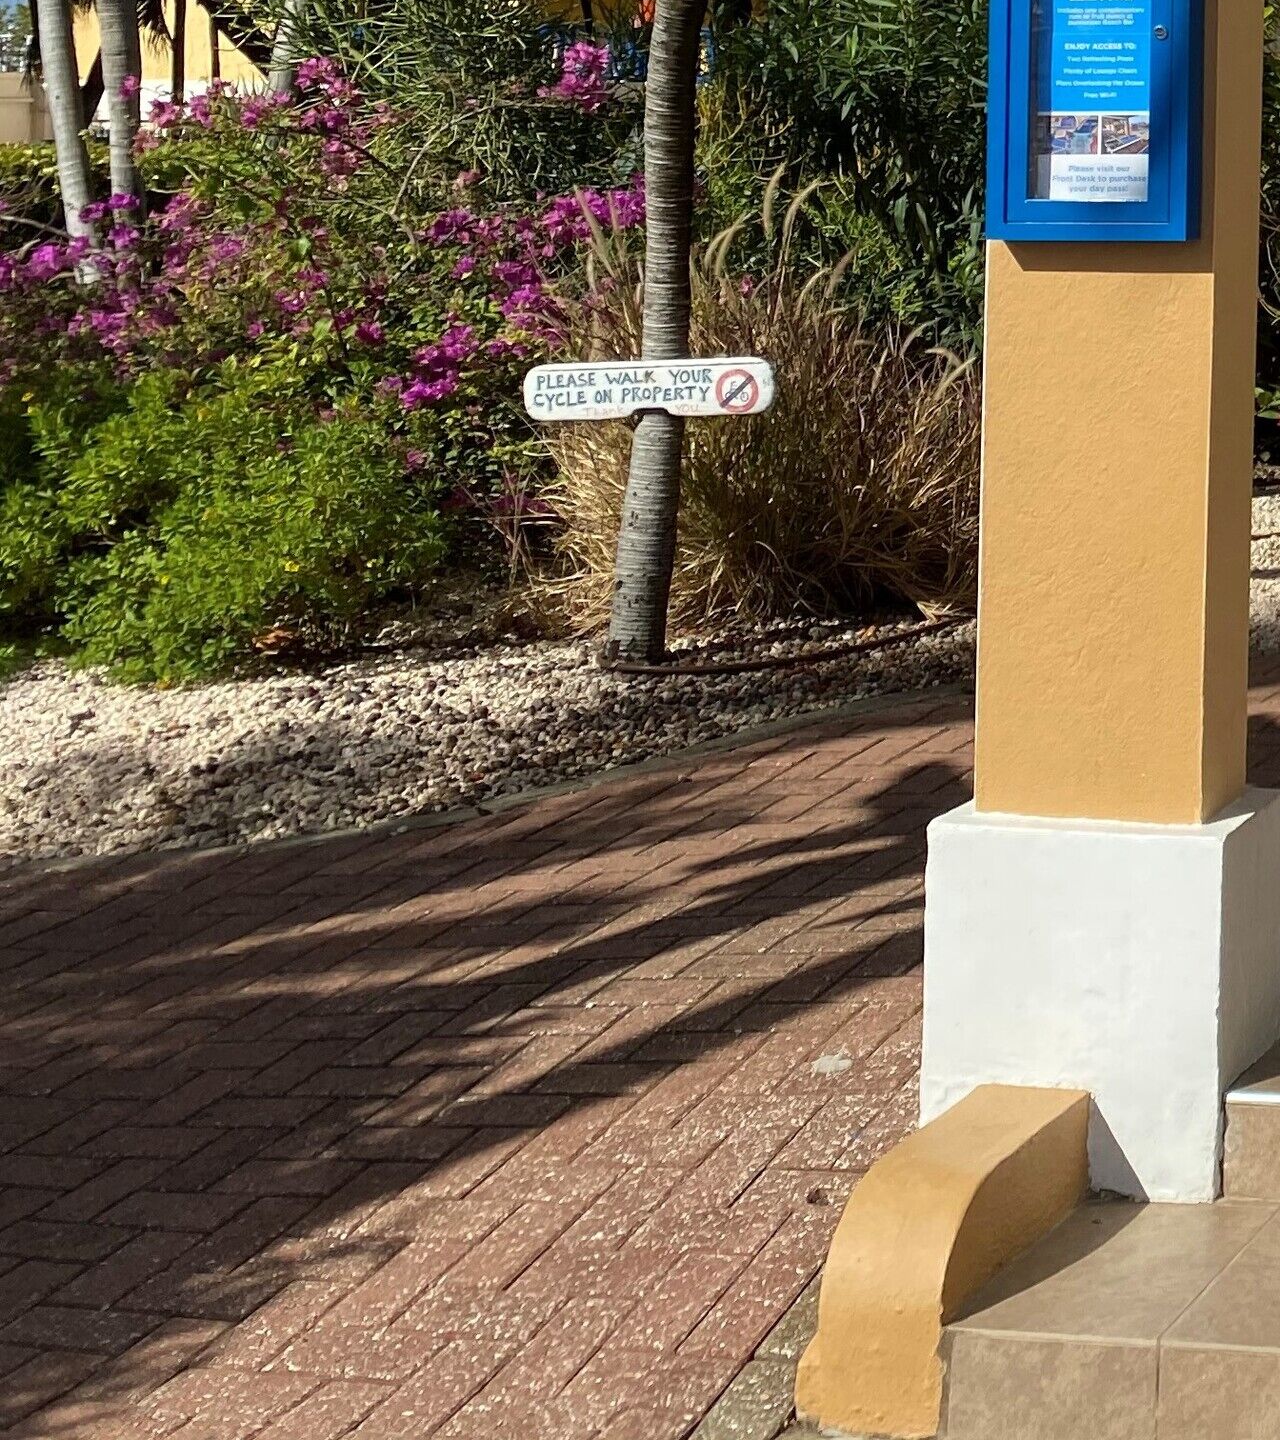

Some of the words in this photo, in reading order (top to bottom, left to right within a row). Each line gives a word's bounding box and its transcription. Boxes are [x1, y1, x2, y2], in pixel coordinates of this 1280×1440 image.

[1109, 175, 1147, 183] purchase
[536, 372, 597, 391] PLEASE
[605, 369, 656, 385] WALK
[668, 368, 713, 386] YOUR
[533, 391, 587, 410] CYCLE
[594, 389, 612, 404] ON
[621, 385, 711, 404] PROPERTY
